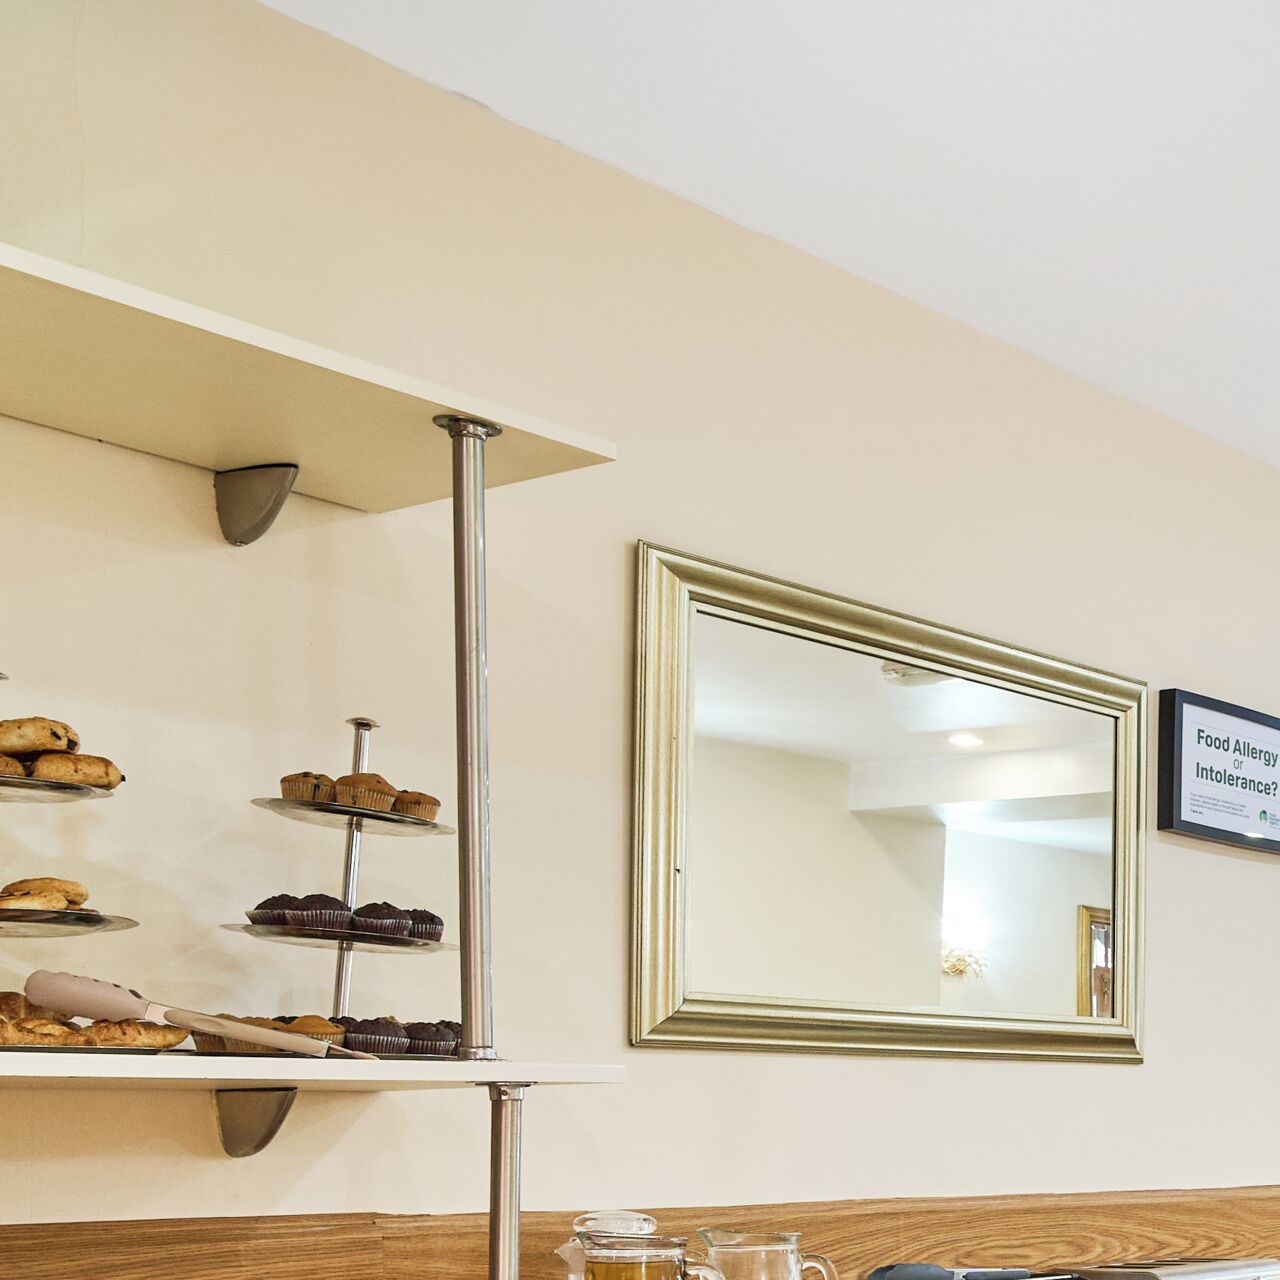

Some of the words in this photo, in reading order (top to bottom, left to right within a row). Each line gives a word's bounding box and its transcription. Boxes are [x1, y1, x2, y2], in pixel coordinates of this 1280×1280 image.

[1197, 728, 1230, 752] Food
[1233, 739, 1279, 768] Allergy
[1233, 758, 1244, 770] or
[1196, 762, 1279, 797] Intolerance?
